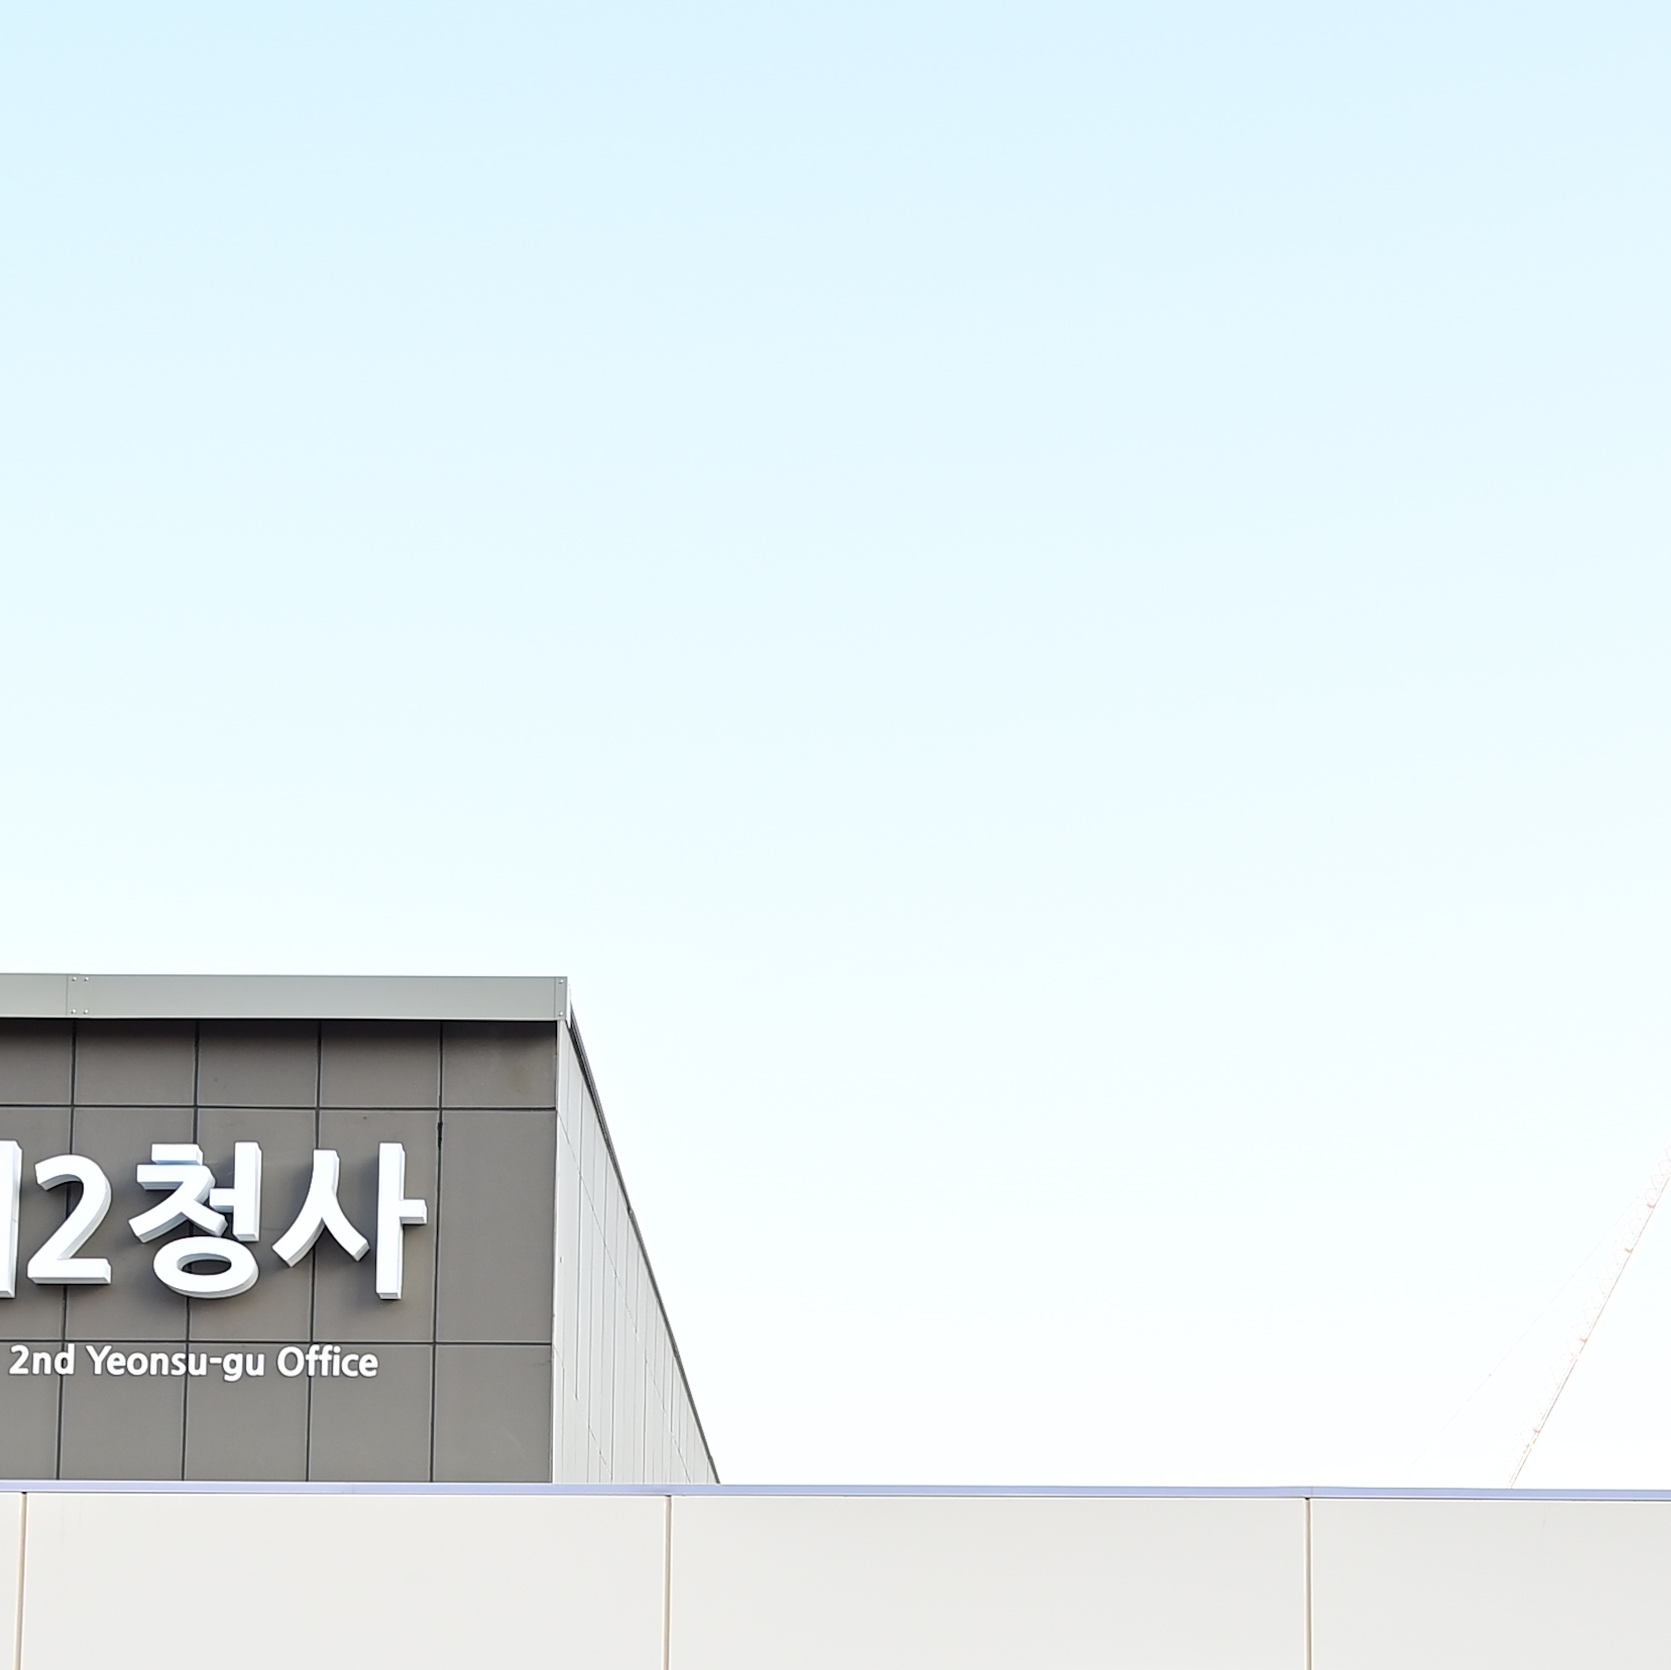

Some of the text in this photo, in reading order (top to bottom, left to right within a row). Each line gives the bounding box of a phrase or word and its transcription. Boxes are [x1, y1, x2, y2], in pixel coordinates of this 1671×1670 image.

[9, 1344, 380, 1382] 2nd Yeonsu-gu Office
